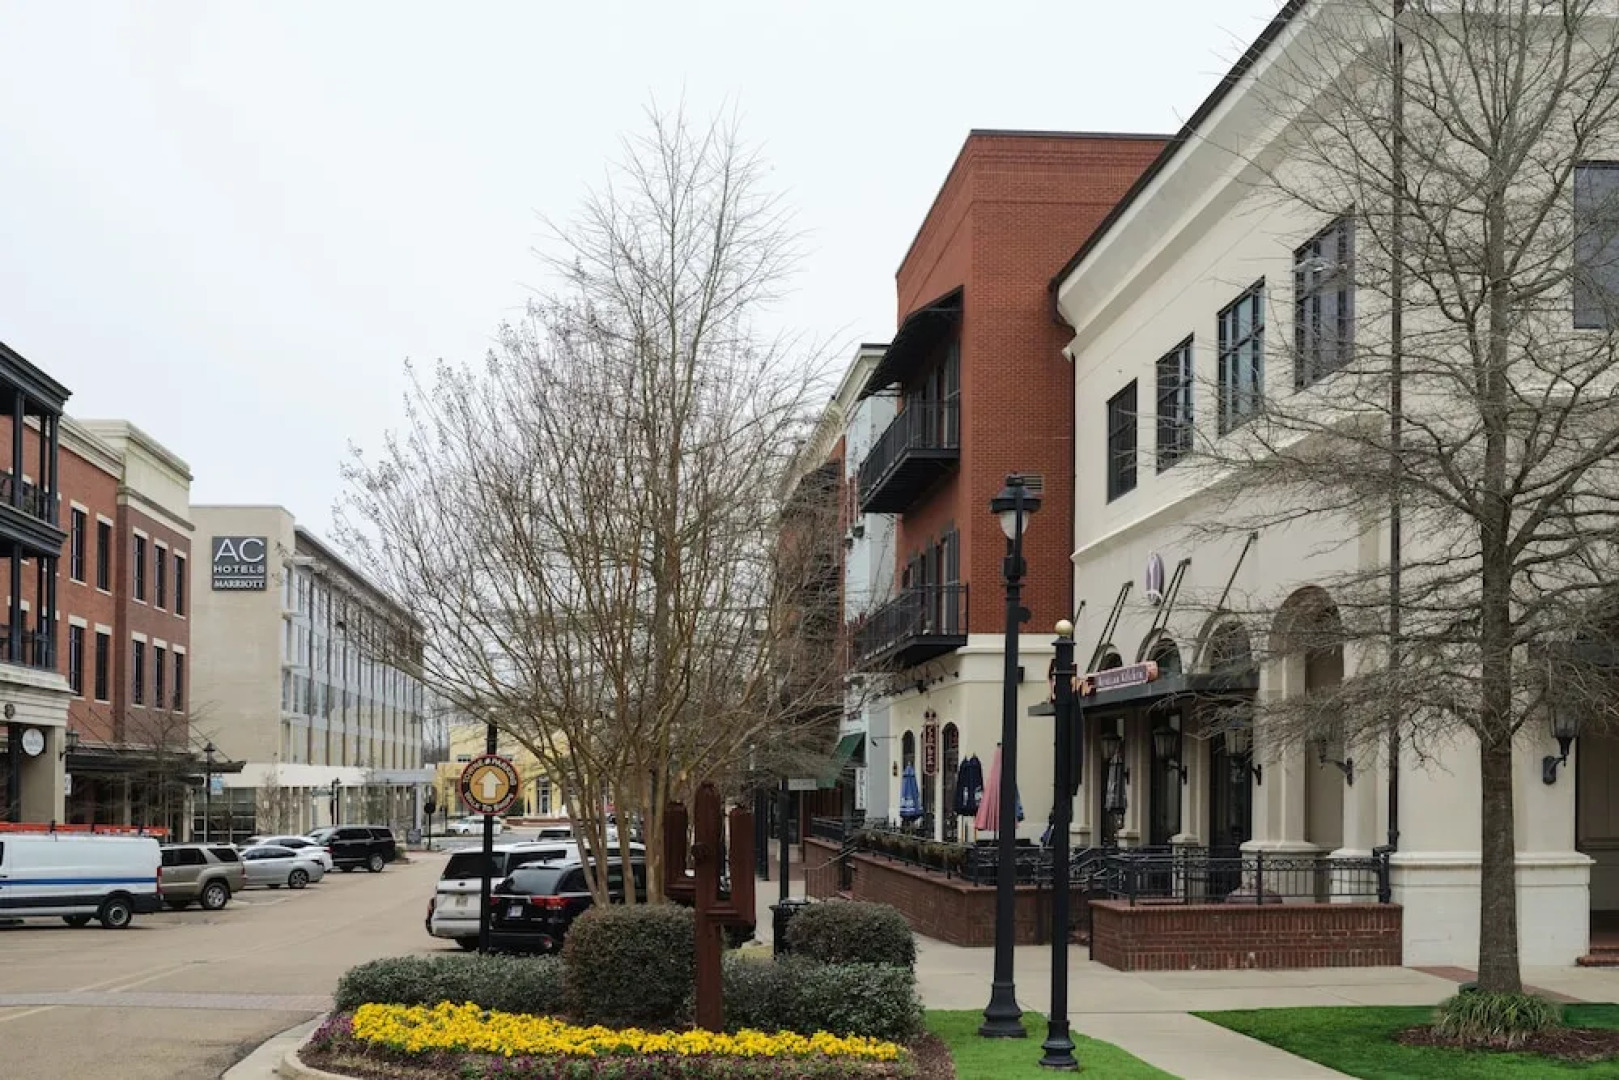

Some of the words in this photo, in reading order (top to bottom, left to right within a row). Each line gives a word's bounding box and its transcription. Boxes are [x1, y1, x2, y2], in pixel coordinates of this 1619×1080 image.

[214, 538, 264, 562] AC
[213, 564, 264, 574] HOTELS
[213, 580, 264, 589] MARRIOTT
